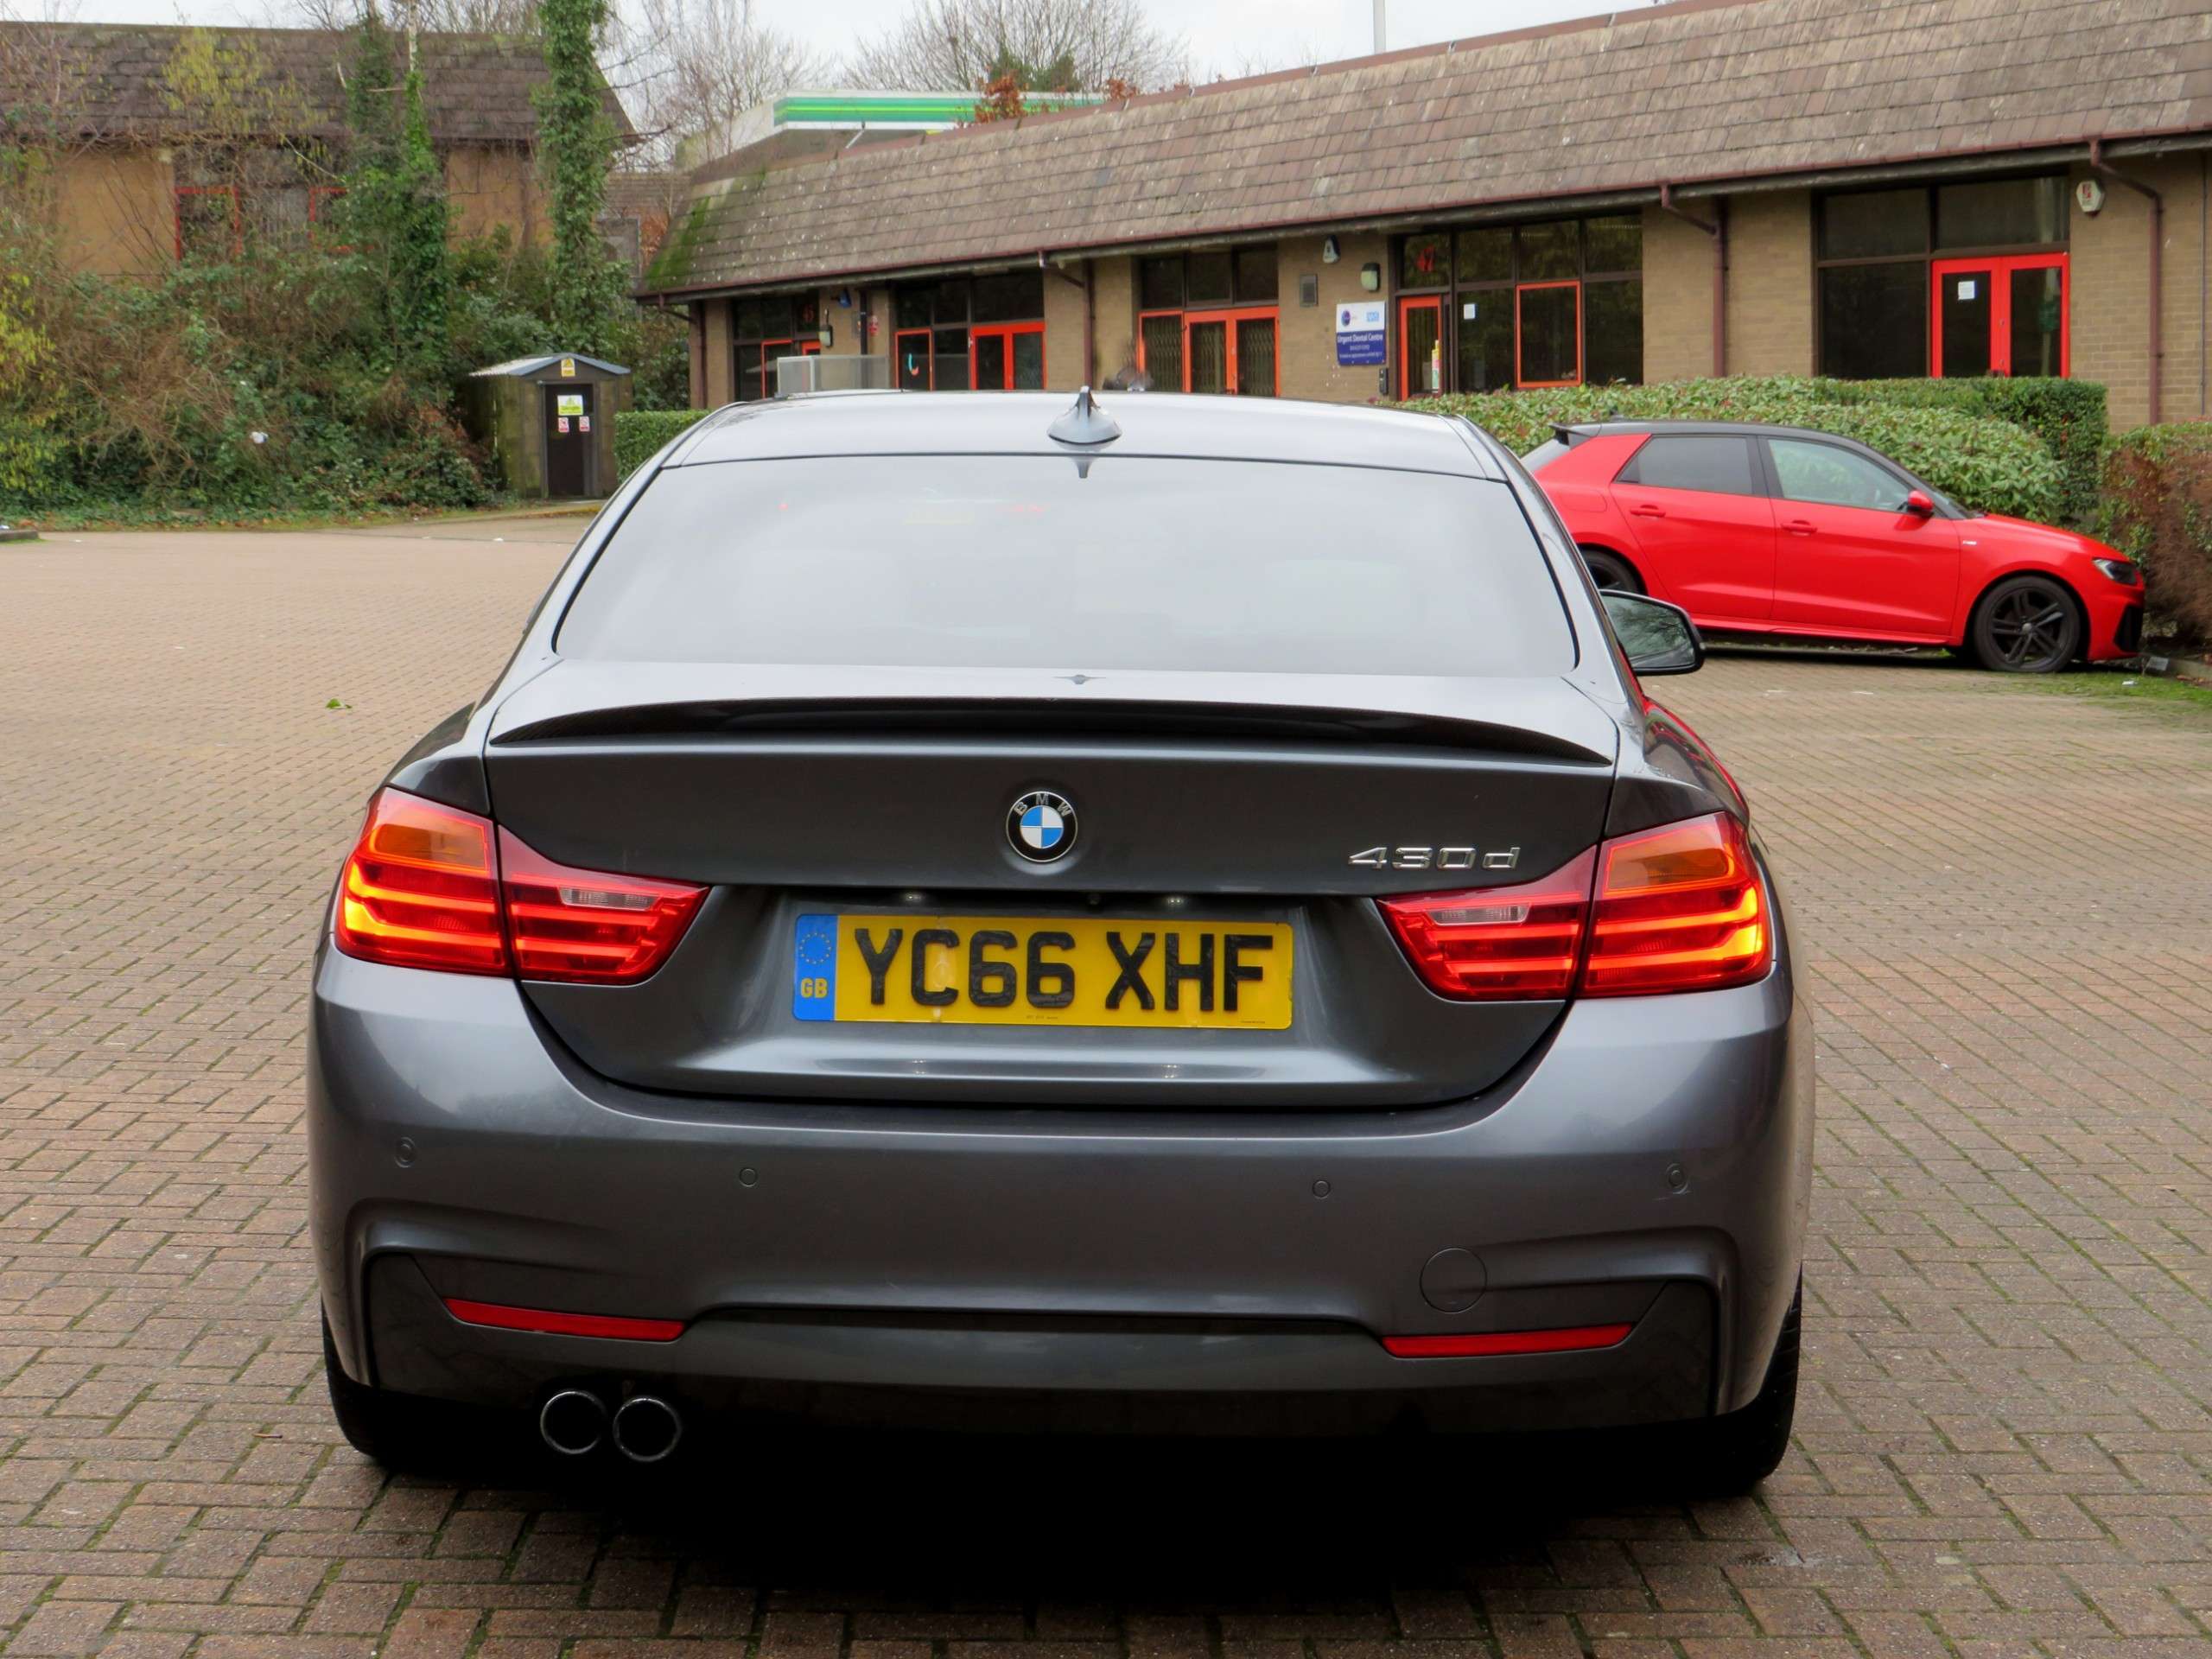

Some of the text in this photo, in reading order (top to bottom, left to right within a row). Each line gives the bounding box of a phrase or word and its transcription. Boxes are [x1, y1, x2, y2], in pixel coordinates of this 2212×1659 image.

[1337, 333, 1383, 345] Urgent Dental Centre
[1014, 793, 1072, 817] BMW
[1347, 847, 1521, 869] 430d
[854, 928, 1274, 1013] YC66 XHF
[801, 977, 828, 998] GB
